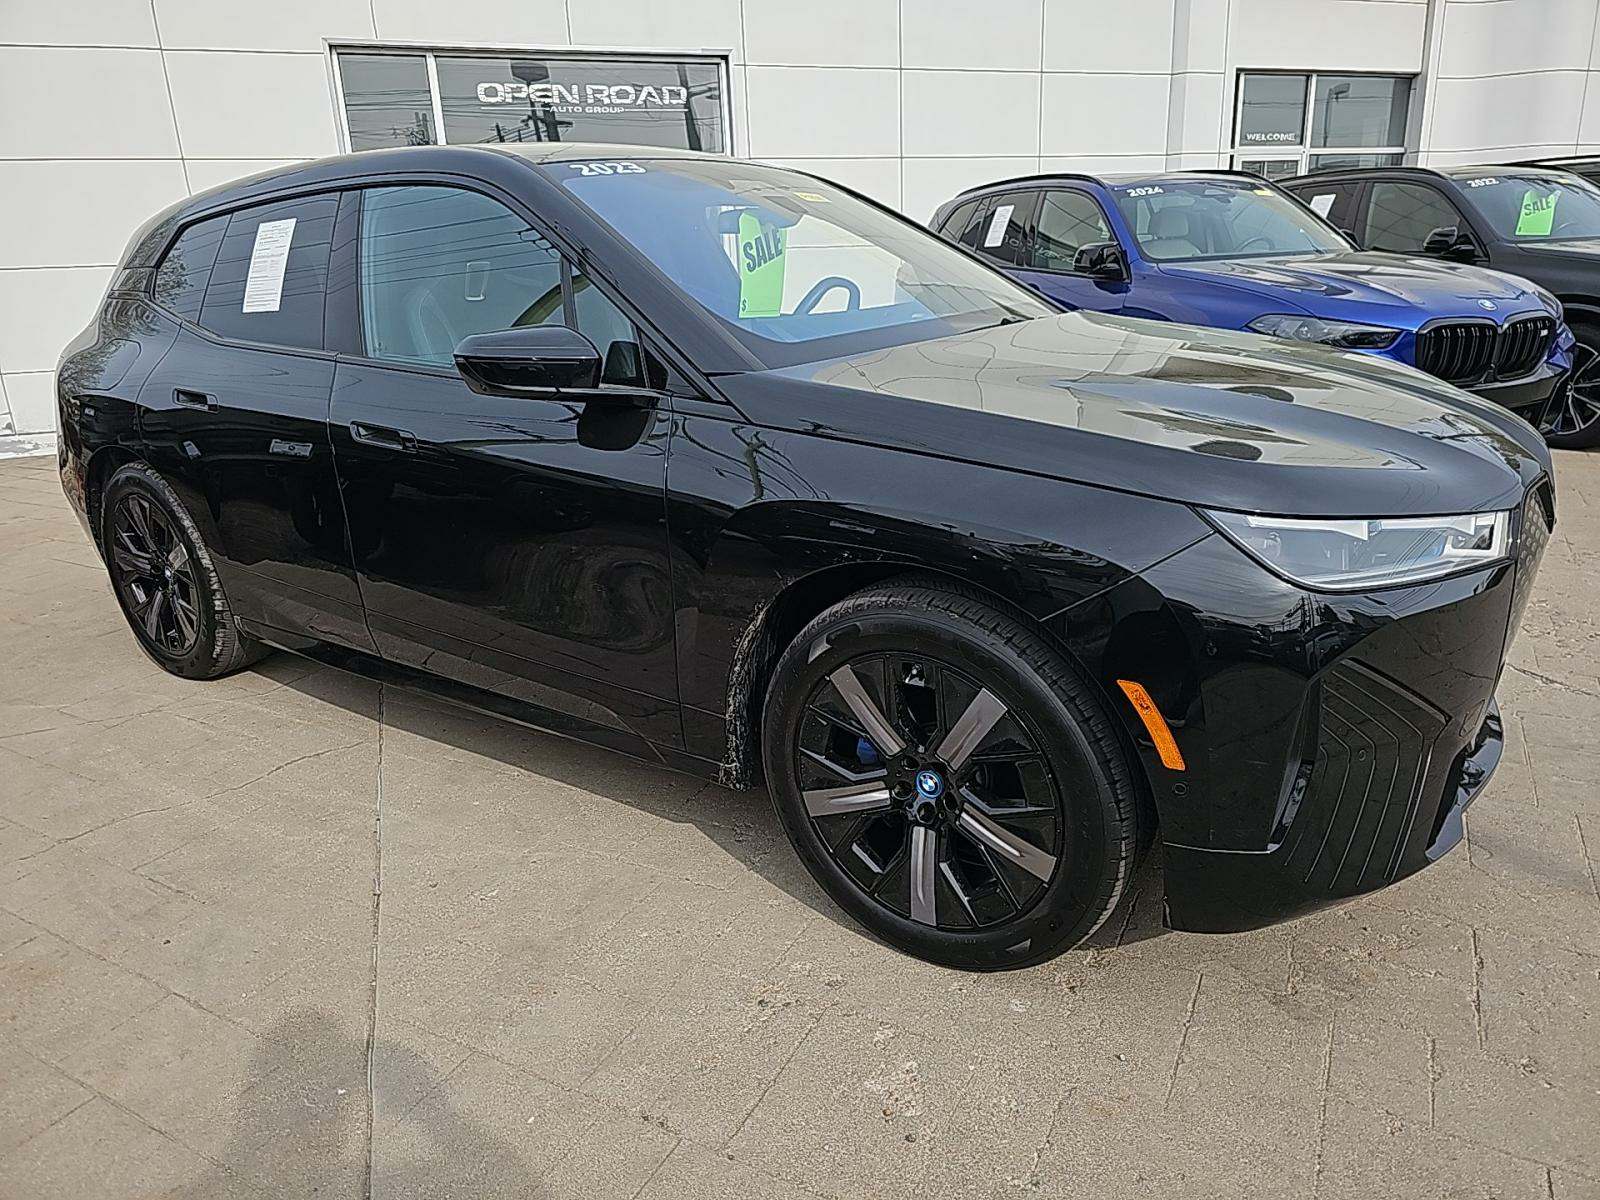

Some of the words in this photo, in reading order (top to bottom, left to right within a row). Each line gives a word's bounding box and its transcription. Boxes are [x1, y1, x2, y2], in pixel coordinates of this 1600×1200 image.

[477, 82, 579, 104] OPEN
[587, 84, 688, 106] ROAD
[549, 105, 583, 113] AUTO
[585, 106, 625, 114] GROUP
[1246, 132, 1296, 141] WELCOME
[568, 162, 647, 176] 2023
[1126, 185, 1165, 198] 2024
[1523, 197, 1553, 217] SALE
[743, 227, 784, 273] SALE
